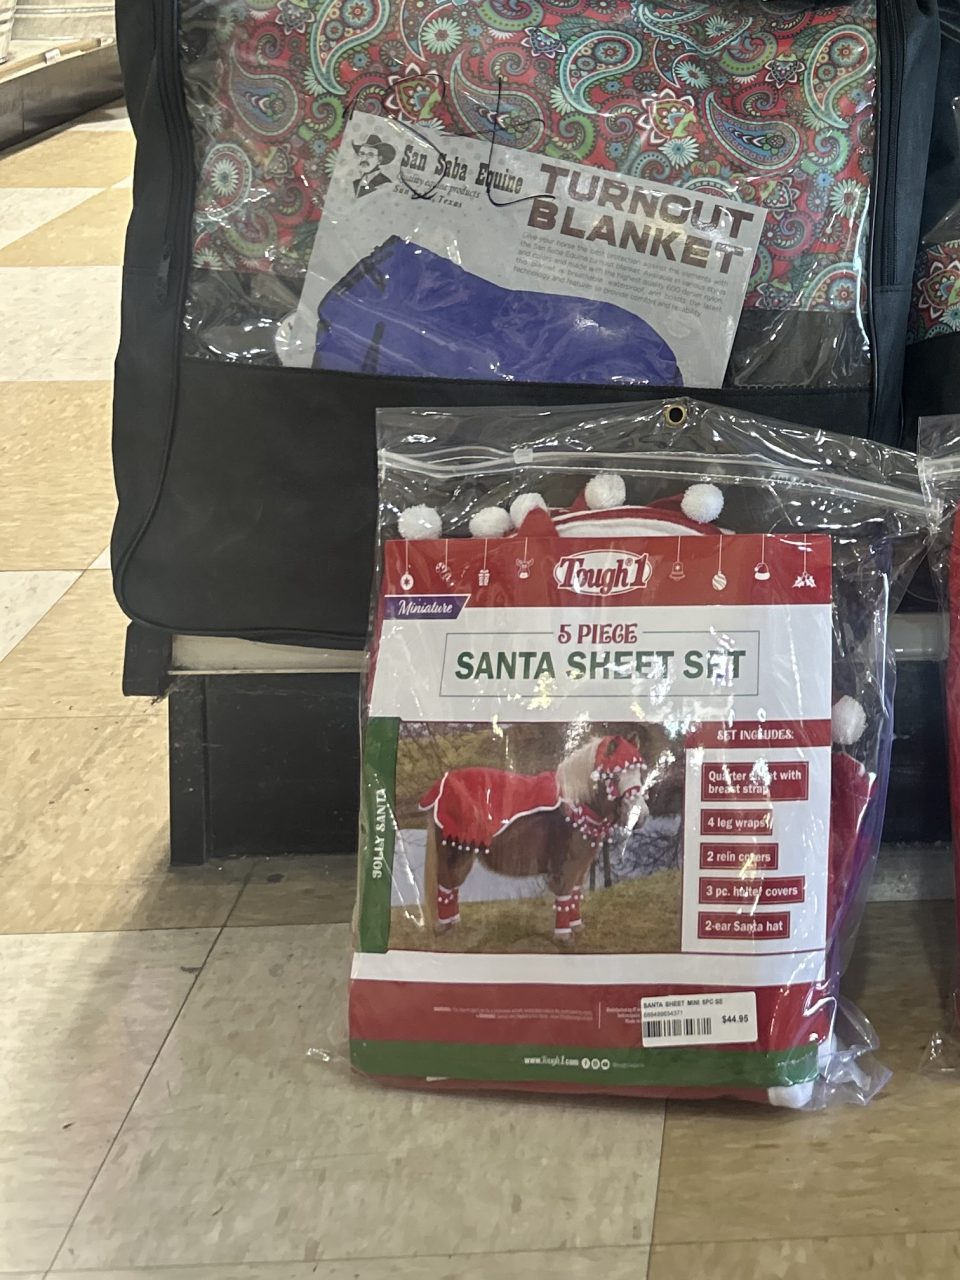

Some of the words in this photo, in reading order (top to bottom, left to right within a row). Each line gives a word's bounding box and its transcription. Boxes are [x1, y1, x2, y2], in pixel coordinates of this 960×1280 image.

[401, 144, 427, 171] San
[434, 152, 469, 181] Saba
[475, 162, 524, 195] Equine
[439, 194, 463, 208] Texas
[540, 163, 754, 239] TURNOUT
[527, 197, 744, 274] BLANKET
[398, 599, 454, 617] Miniature
[558, 624, 572, 644] 5
[577, 623, 638, 644] PIECE
[455, 651, 555, 680] SANTA
[566, 650, 674, 680] SHEET
[717, 729, 737, 740] SET
[780, 770, 802, 780] with
[708, 784, 741, 794] breast
[743, 785, 769, 796] strap
[375, 788, 387, 832] SANTA
[707, 817, 715, 827] 4
[717, 817, 733, 829] leg
[735, 818, 766, 829] wraps
[372, 835, 385, 879] JOLLY
[707, 851, 714, 862] 2
[716, 851, 736, 862] rein
[706, 885, 713, 896] 3
[715, 887, 730, 898] pc.
[765, 886, 798, 896] covers
[705, 920, 731, 931] 2-ear
[733, 921, 763, 932] Santa
[766, 921, 783, 931] hat
[643, 1001, 663, 1009] SANTA
[665, 1000, 685, 1008] SHEET
[722, 1014, 749, 1024] $44.95
